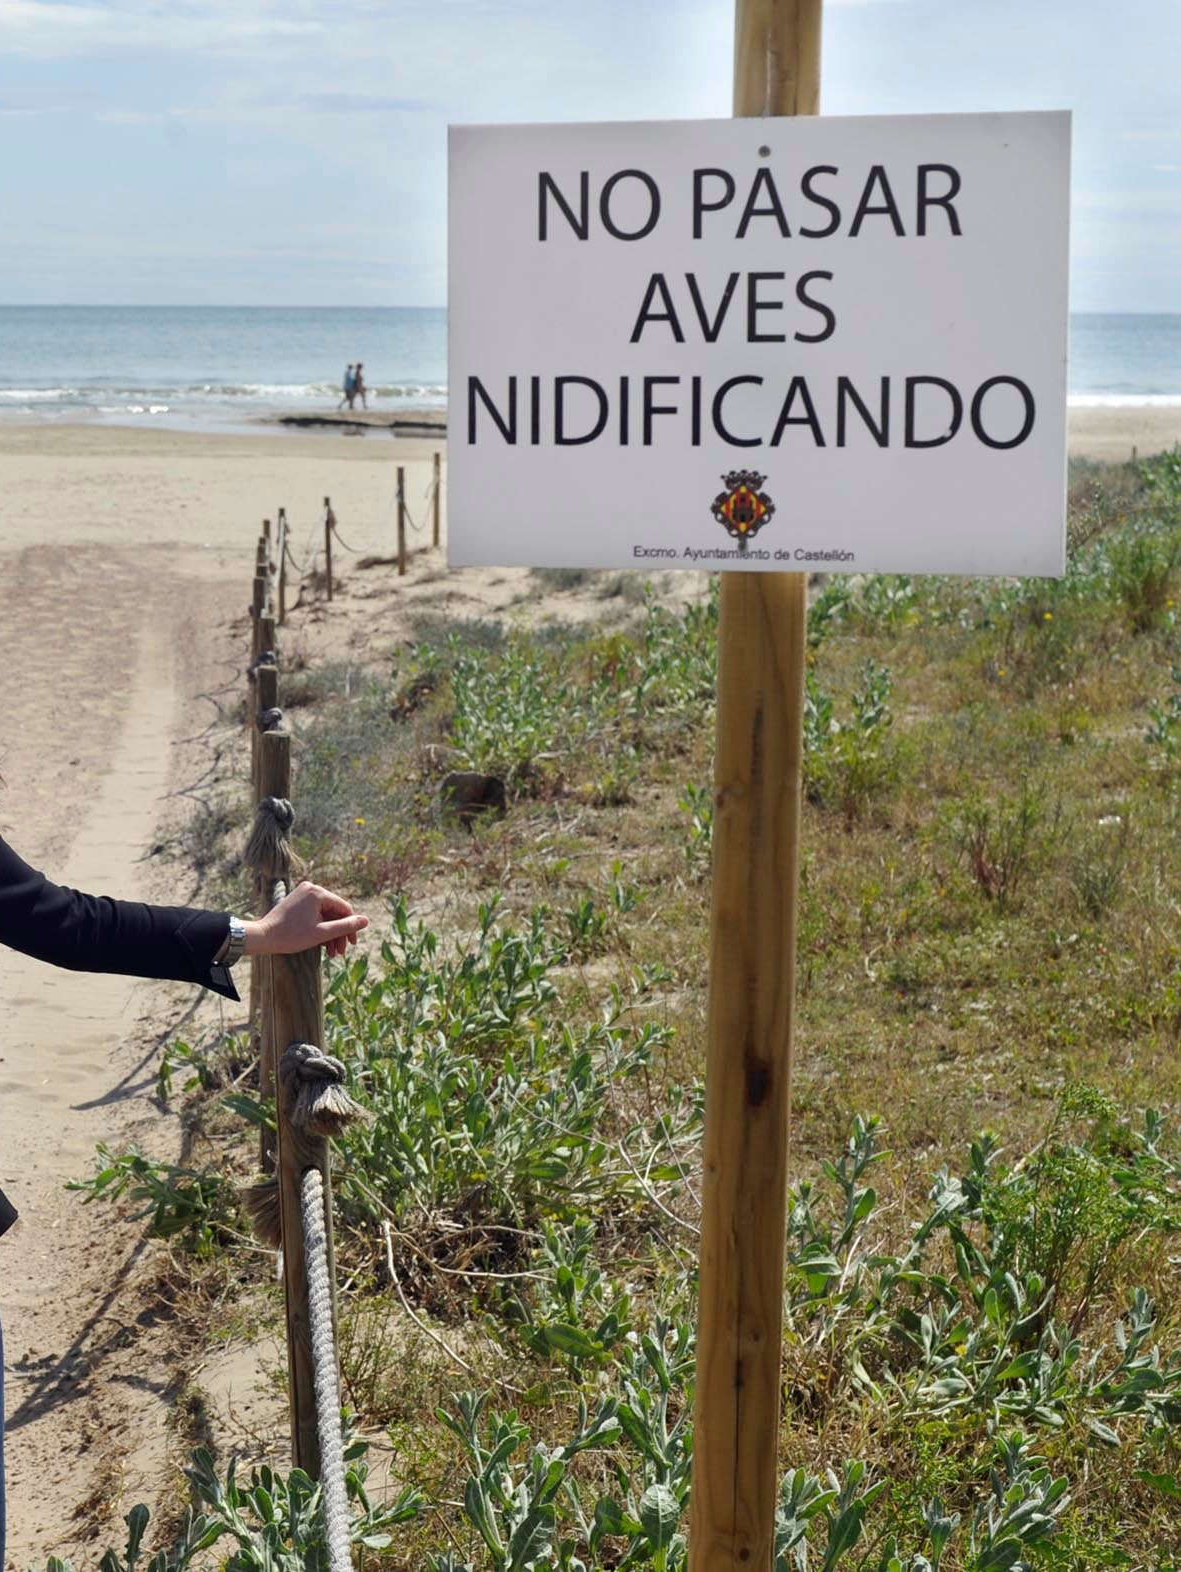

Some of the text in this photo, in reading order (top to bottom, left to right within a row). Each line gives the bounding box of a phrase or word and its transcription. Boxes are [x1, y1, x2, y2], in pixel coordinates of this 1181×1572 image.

[538, 163, 963, 242] NO PASAR
[629, 270, 836, 344] AVES
[467, 374, 1036, 450] NIDIFICANDO
[633, 545, 855, 562] Excmo. Ayuntamiento de Castellón
